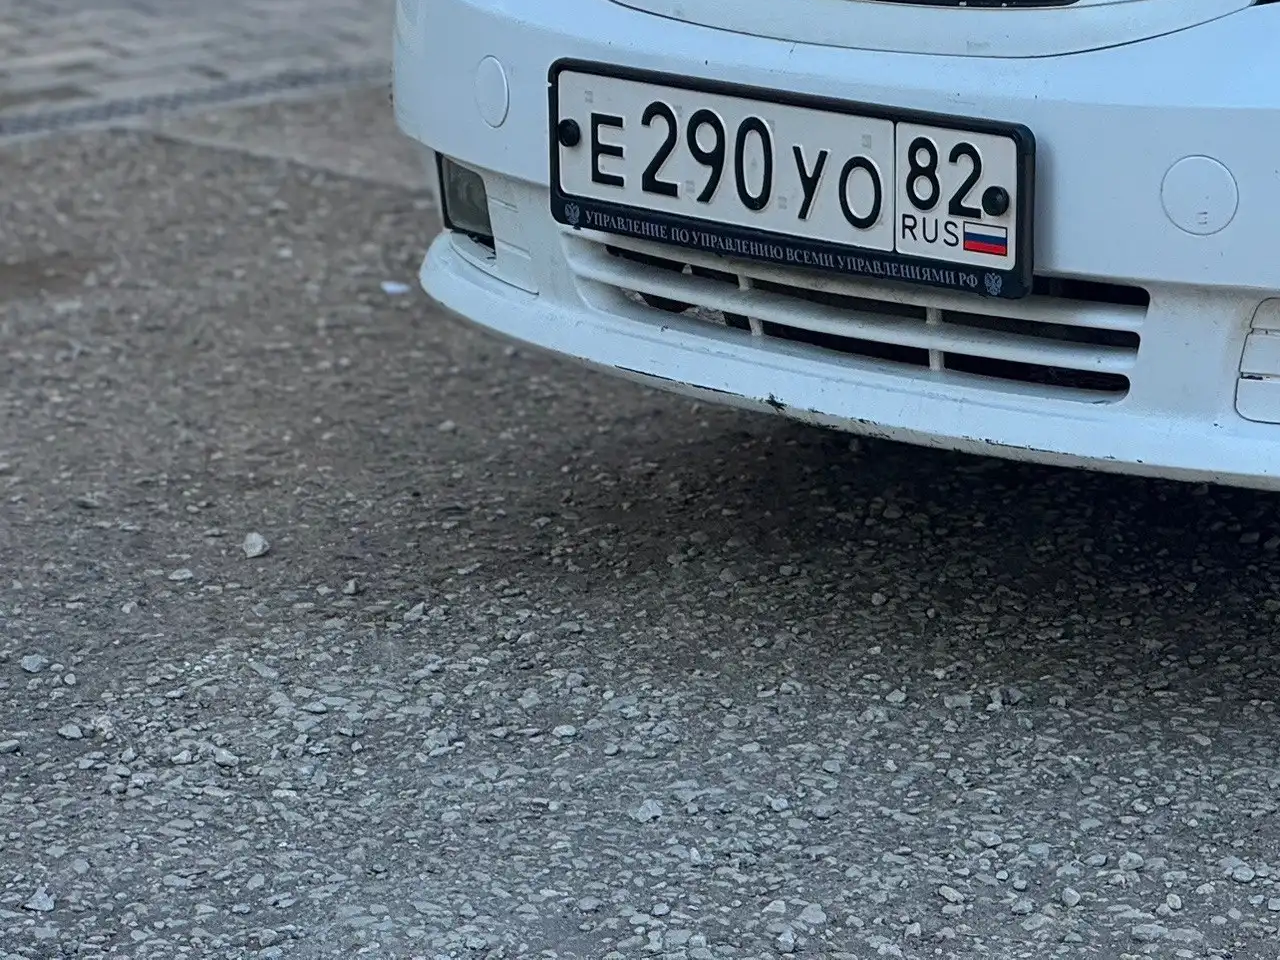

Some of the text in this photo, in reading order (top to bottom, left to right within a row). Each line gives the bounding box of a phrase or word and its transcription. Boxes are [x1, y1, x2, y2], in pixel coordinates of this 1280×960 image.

[905, 136, 983, 220] 82
[585, 210, 979, 289] УПРАВЛЕНИЕ ПО УПРАВЛЕНИЮ ВСЕМИ УПРАВЛЕНИЯМИ РФ
[901, 214, 960, 248] RUS
